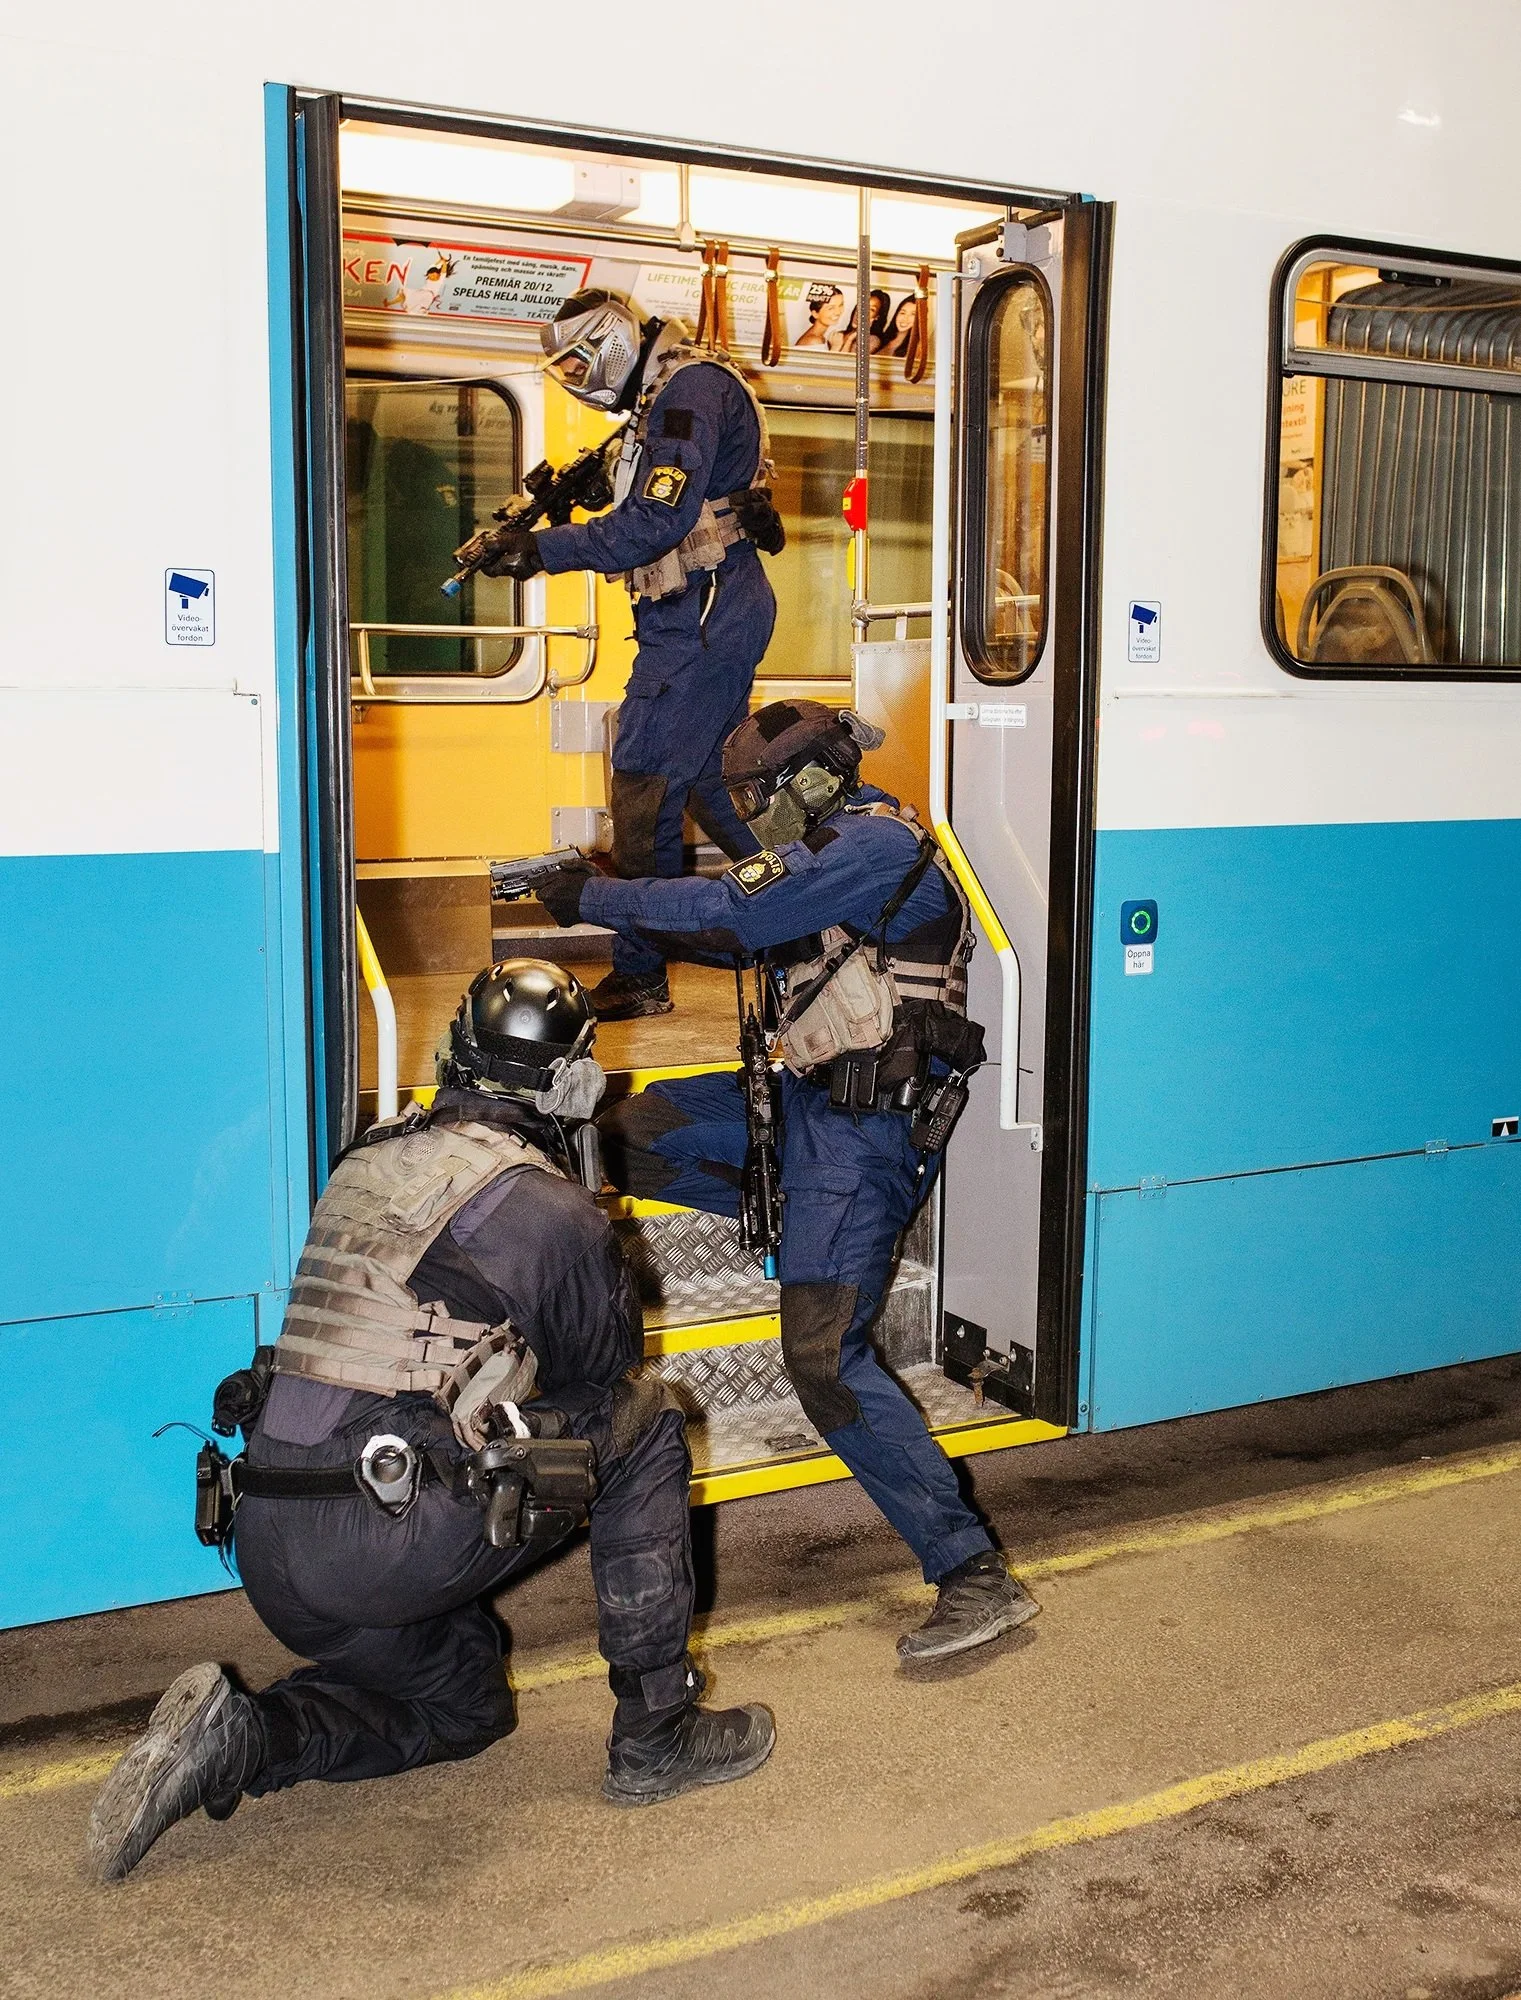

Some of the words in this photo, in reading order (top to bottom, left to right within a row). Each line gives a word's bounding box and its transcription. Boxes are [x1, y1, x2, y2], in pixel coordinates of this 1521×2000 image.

[471, 264, 499, 272] spänning
[472, 256, 506, 265] familjefest
[522, 261, 538, 269] sång,
[540, 263, 560, 271] musik,
[561, 265, 577, 273] dans,
[343, 257, 411, 286] KEN
[475, 276, 521, 289] PREMIÄR
[523, 281, 554, 293] 20/12.
[647, 273, 697, 286] LIFETIME
[452, 287, 492, 300] SPELAS
[493, 290, 518, 302] HELA
[810, 284, 834, 296] 25%
[655, 468, 684, 482] POLIS
[178, 614, 202, 622] Video-
[172, 624, 209, 632] övervakat
[177, 634, 203, 642] fordon
[758, 852, 781, 874] POLIS
[1127, 950, 1151, 959] Öppna
